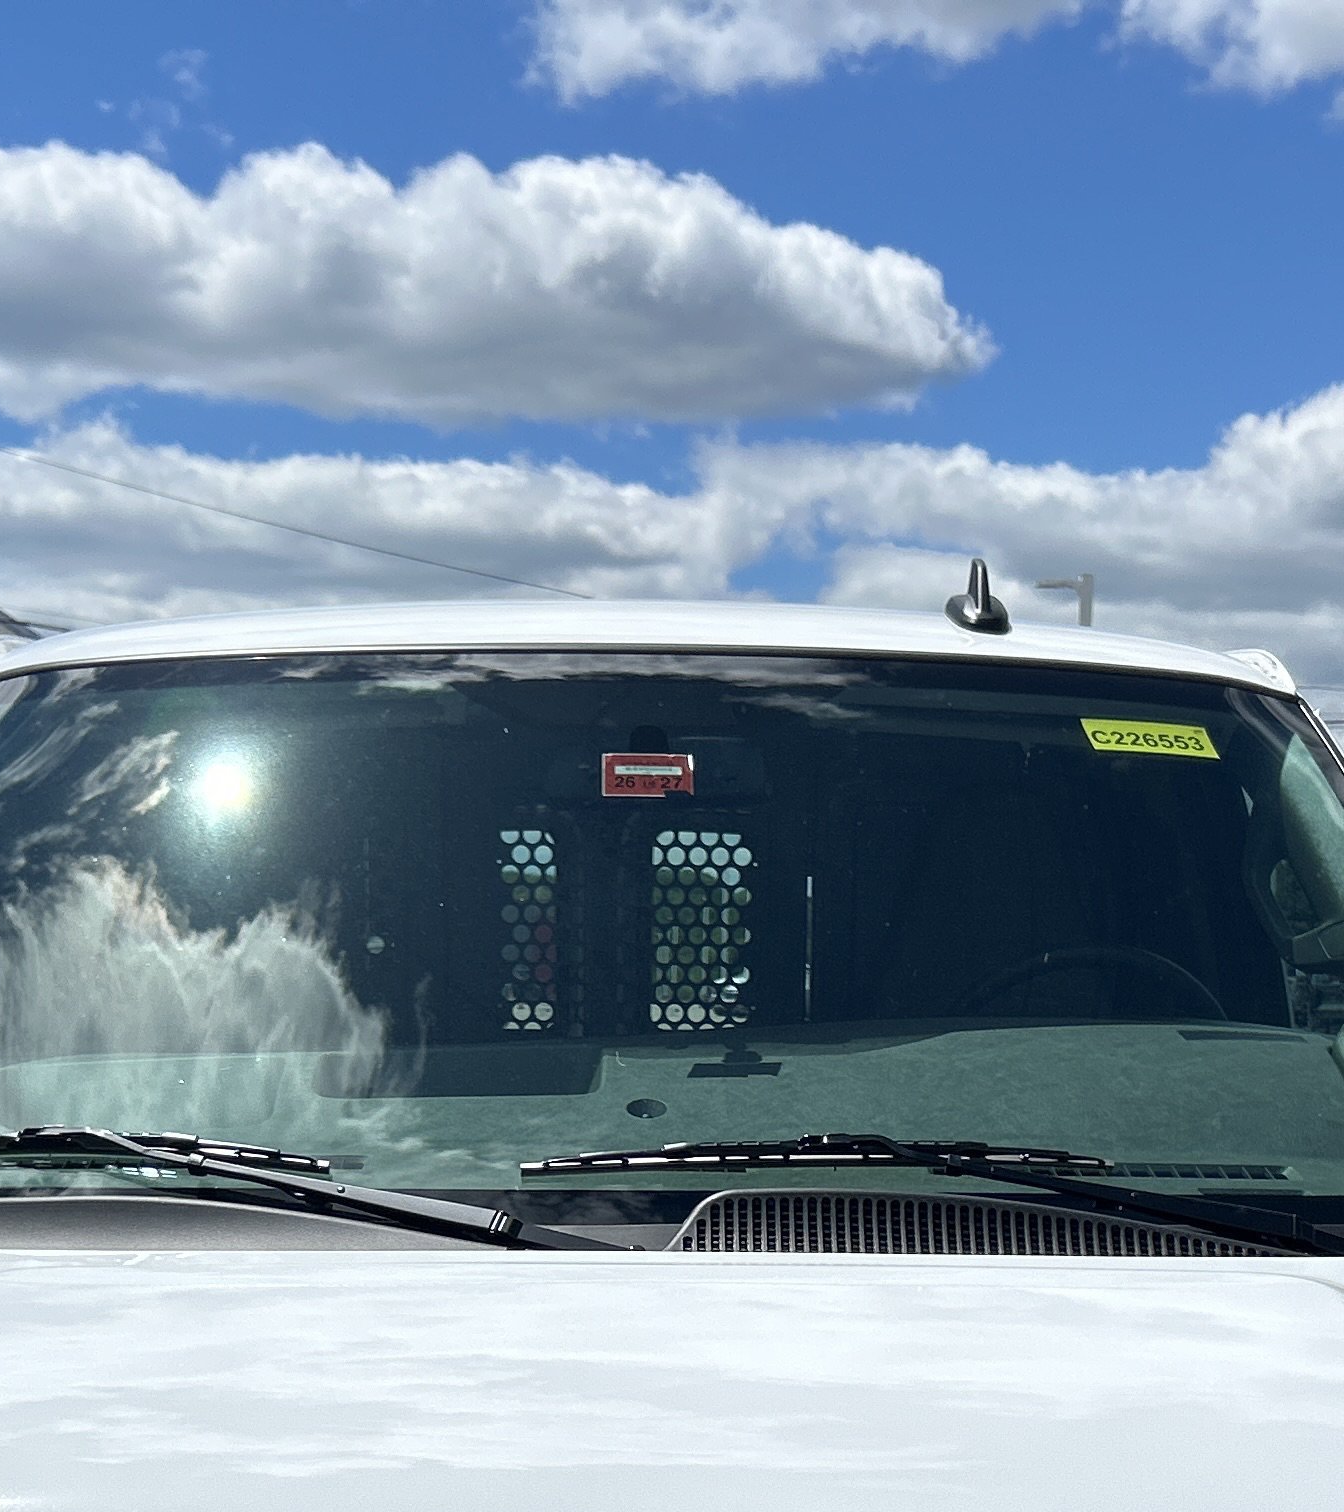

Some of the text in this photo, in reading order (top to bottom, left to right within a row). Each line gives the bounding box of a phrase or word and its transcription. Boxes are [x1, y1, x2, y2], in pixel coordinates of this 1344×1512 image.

[1091, 730, 1205, 751] C226553
[615, 776, 636, 789] 26
[660, 777, 683, 789] 27
